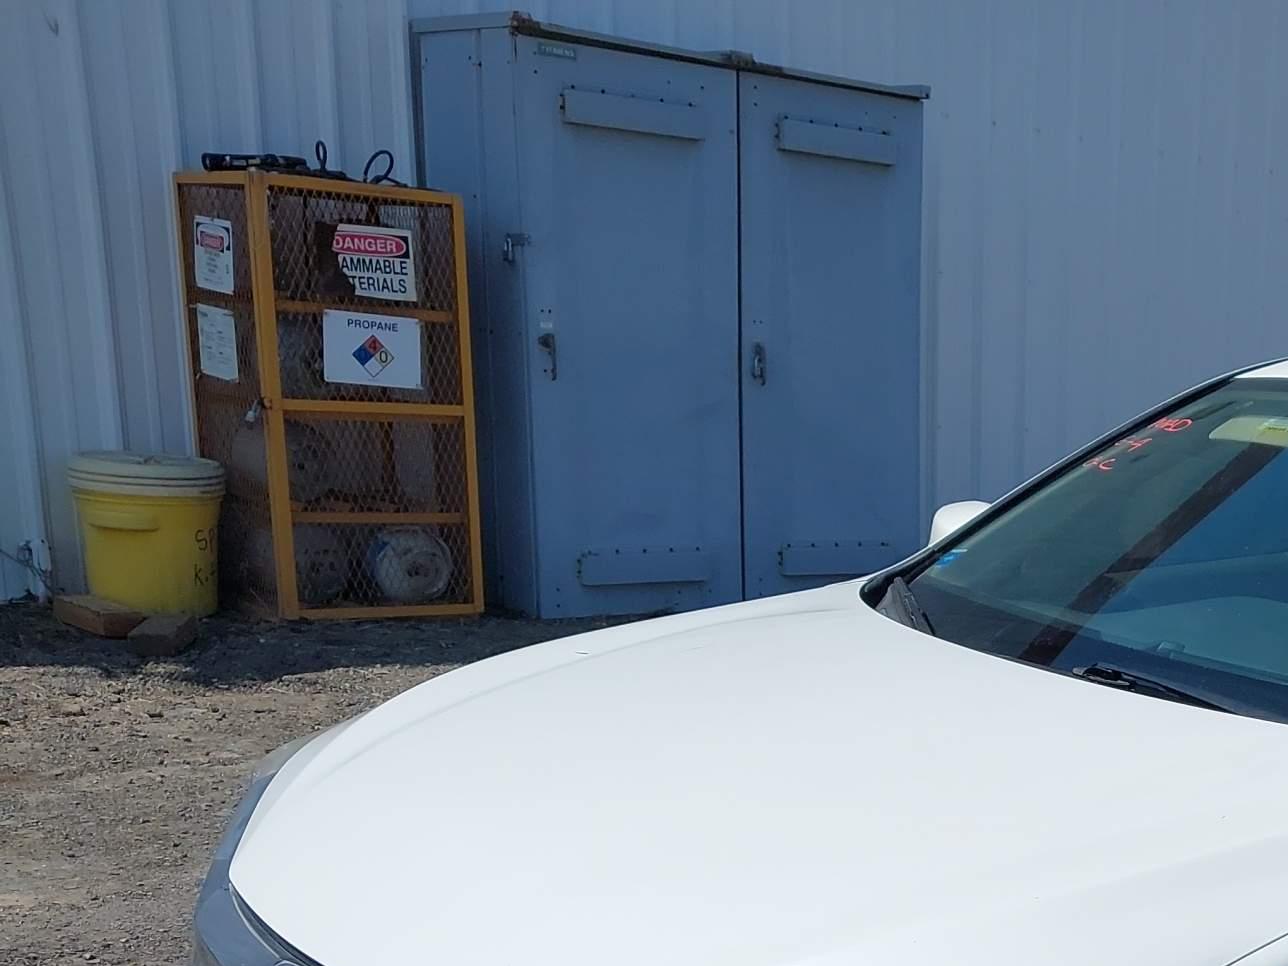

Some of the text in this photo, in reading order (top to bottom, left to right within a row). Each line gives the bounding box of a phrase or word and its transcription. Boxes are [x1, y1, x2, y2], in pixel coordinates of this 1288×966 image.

[333, 236, 397, 253] DANGER
[341, 256, 408, 276] AMMABLE
[348, 275, 407, 294] TERIALS
[347, 319, 399, 332] PROPANE
[368, 339, 378, 352] 4
[379, 350, 388, 363] 0
